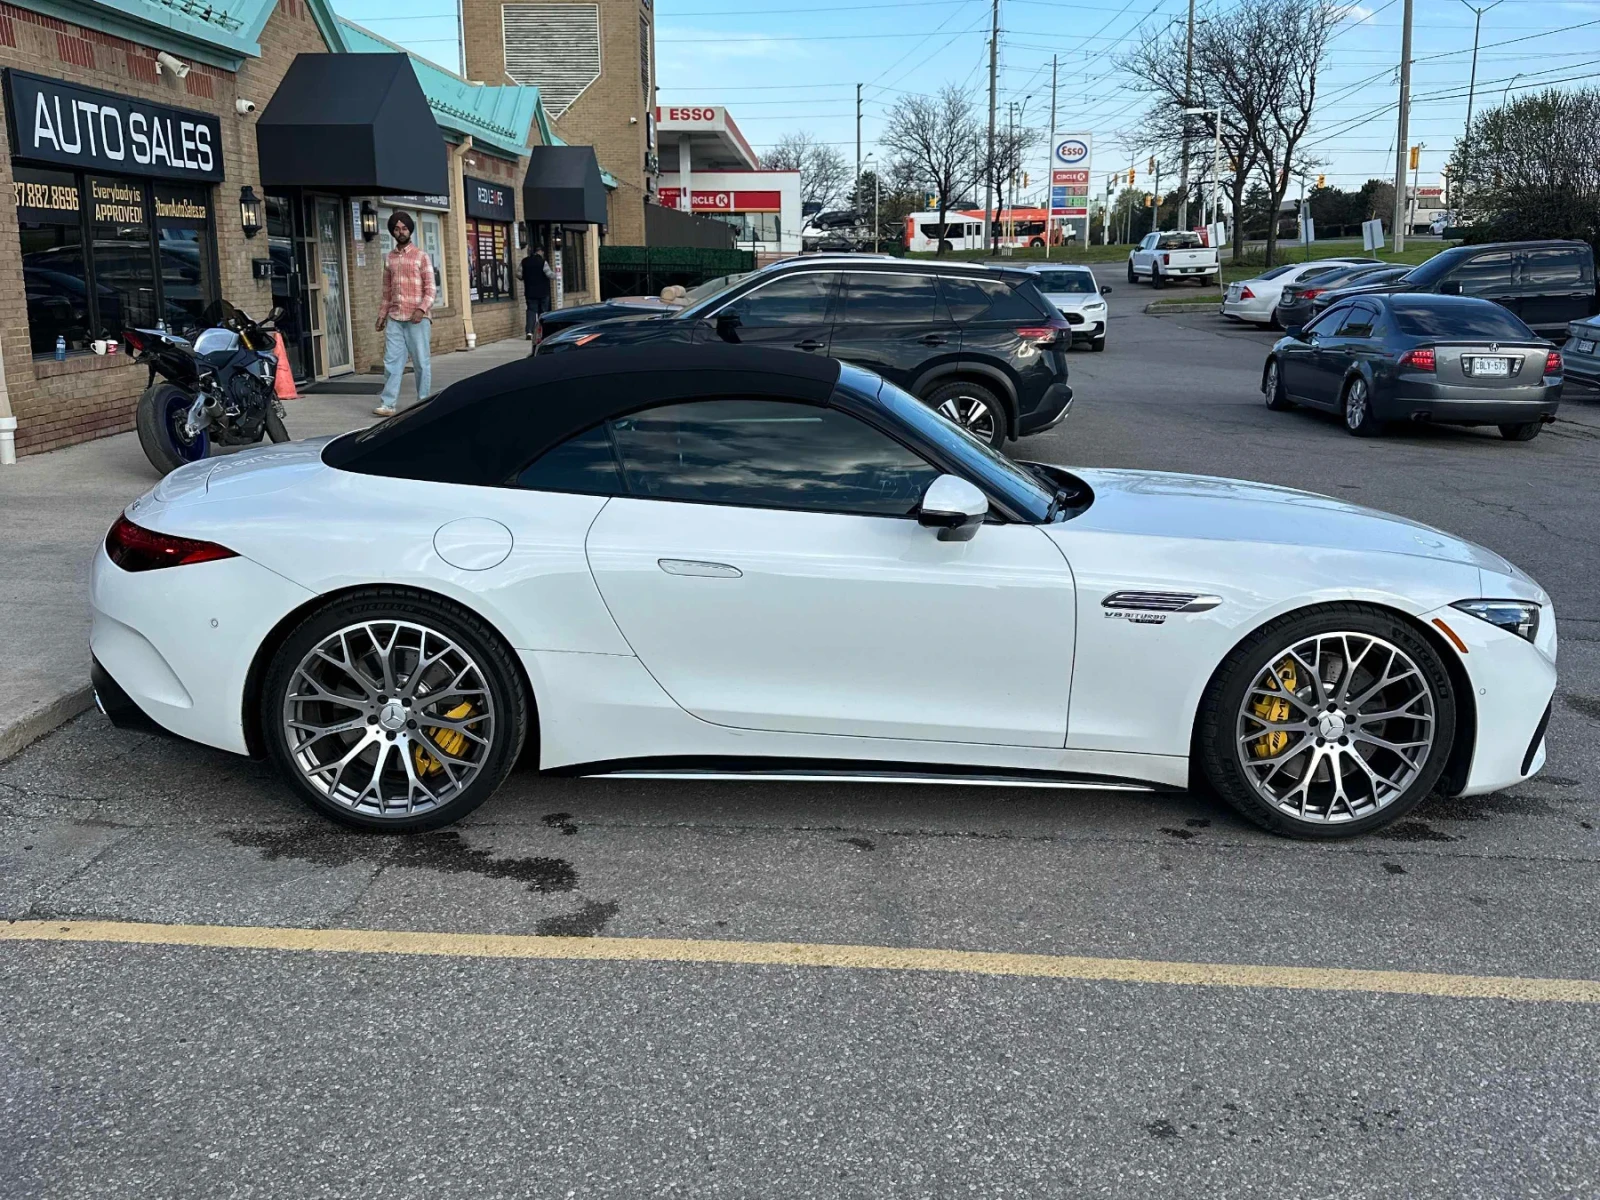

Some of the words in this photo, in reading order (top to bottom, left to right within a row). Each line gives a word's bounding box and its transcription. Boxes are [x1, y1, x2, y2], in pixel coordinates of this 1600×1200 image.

[669, 108, 715, 121] ESSO
[34, 92, 125, 161] AUTO
[129, 112, 213, 171] SALES
[13, 182, 79, 211] 37.882.8696
[92, 180, 133, 204] Everybody
[133, 187, 141, 202] is
[692, 196, 715, 205] RCLE
[716, 194, 728, 206] K
[95, 203, 143, 223] APPROVED!
[352, 602, 415, 613] MICHELIN
[1406, 638, 1448, 697] MICHELIN
